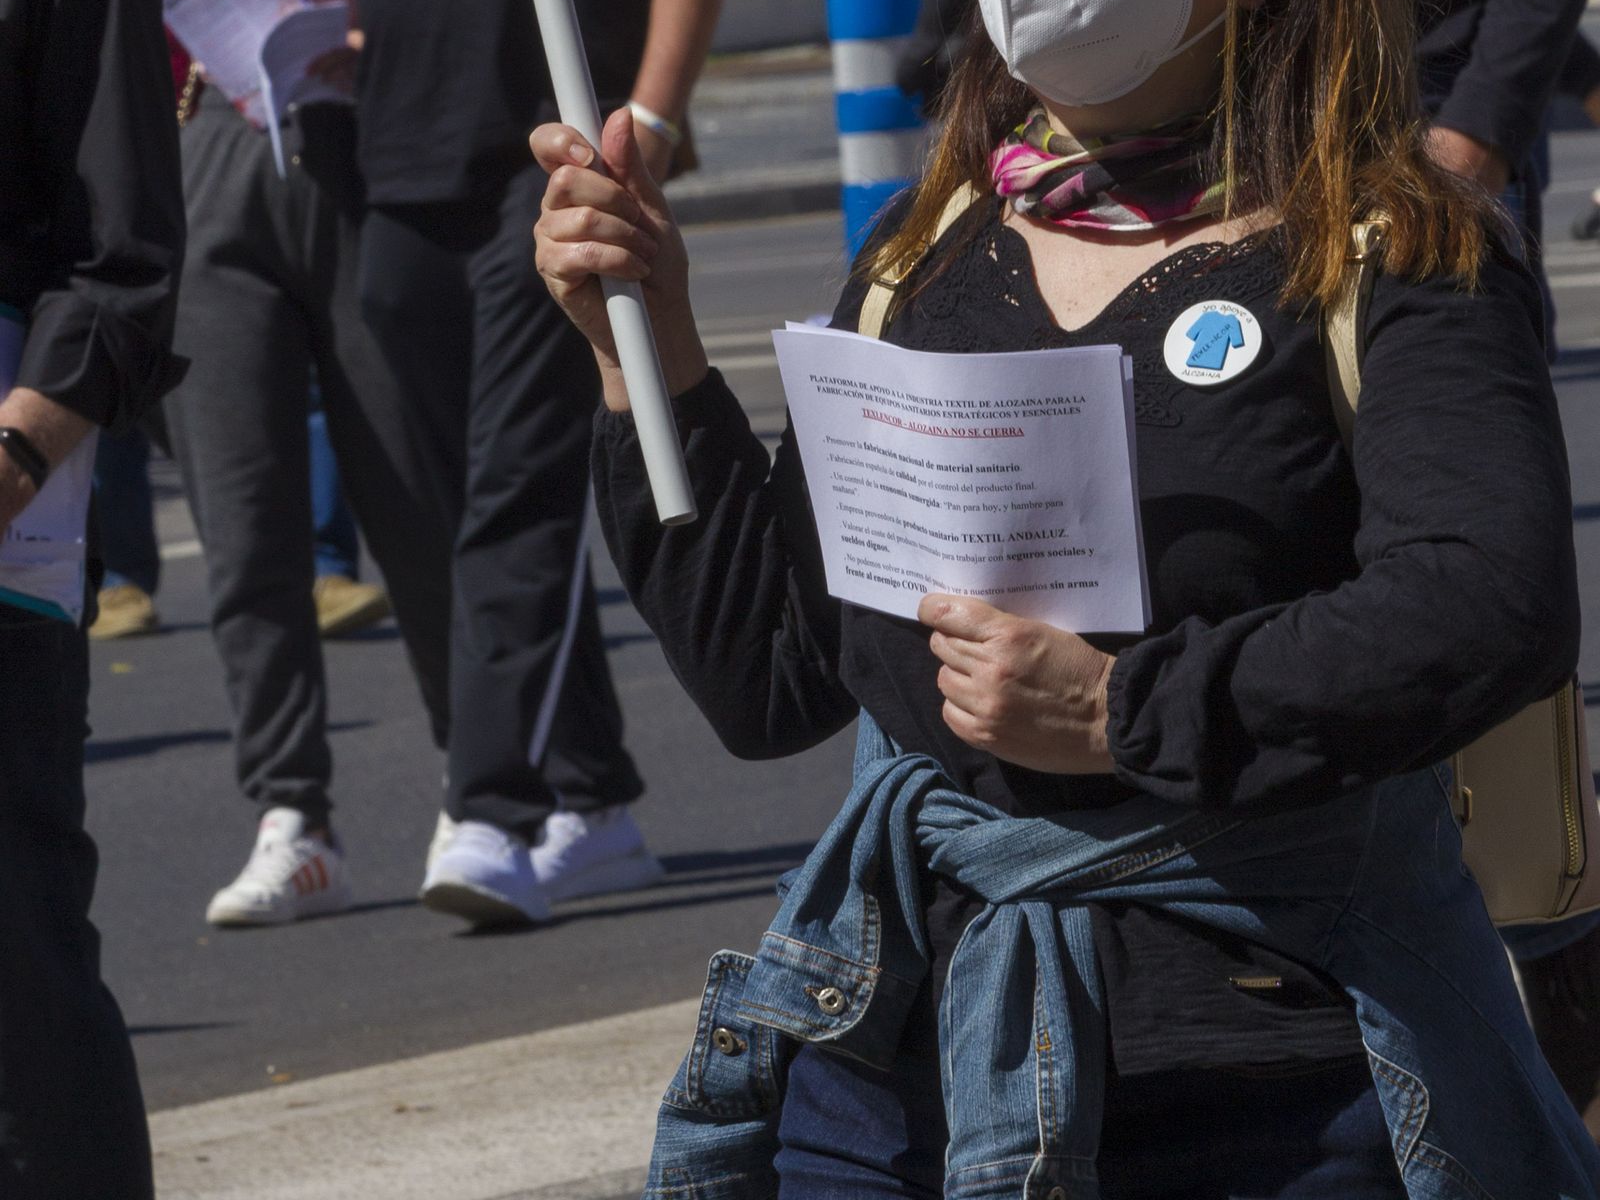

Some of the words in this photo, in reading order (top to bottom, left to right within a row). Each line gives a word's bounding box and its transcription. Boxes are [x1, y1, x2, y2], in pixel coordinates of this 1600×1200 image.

[809, 374, 858, 389] PLATAFORMA
[859, 382, 868, 391] DE
[869, 385, 891, 396] APOYO
[892, 389, 897, 397] A
[897, 390, 905, 400] LA
[906, 393, 943, 408] INDUSTRIA
[944, 399, 977, 409] TEXTIL
[979, 399, 991, 409] DE
[993, 397, 1044, 409] ALOZAINA
[1045, 395, 1072, 406] PARA
[1073, 394, 1087, 404] LA
[816, 385, 865, 400] FABRICACIÓN
[865, 393, 874, 402] DE
[874, 395, 900, 410] EQUIPOS
[900, 402, 941, 419] SANITARIOS
[942, 408, 1012, 420] ESTRATÉGICOS
[1013, 409, 1021, 419] Y
[1022, 406, 1082, 419] ESENCIALES
[862, 407, 903, 427] TEXLENCOR
[908, 422, 950, 438] ALOZAINA
[951, 426, 966, 438] NO
[968, 427, 979, 438] SE
[983, 426, 1025, 438] CIERRA
[857, 441, 863, 450] la
[863, 441, 898, 460] fabricación
[898, 453, 925, 467] nacional
[925, 459, 934, 470] de
[936, 463, 973, 474] material
[975, 462, 1023, 474] sanitario.
[896, 470, 917, 484] calidad
[917, 478, 927, 488] por
[927, 479, 934, 489] el
[934, 482, 959, 493] control
[960, 483, 974, 493] del
[975, 483, 1013, 495] producto
[1015, 481, 1037, 492] final.
[865, 479, 873, 488] de
[873, 480, 879, 490] la
[879, 482, 908, 499] economía
[963, 503, 981, 513] para
[982, 501, 1001, 513] hoy,
[1003, 503, 1009, 513] y
[1011, 500, 1043, 511] hambre
[1045, 500, 1064, 511] para
[841, 534, 865, 548] sueldos
[902, 519, 928, 536] producto
[928, 528, 960, 543] sanitario
[962, 532, 1005, 544] TEXTIL
[1007, 527, 1069, 543] ANDALUZ.
[956, 553, 986, 565] trabajar
[987, 553, 1004, 562] con
[1006, 550, 1045, 563] seguros
[1047, 545, 1086, 558] sociales
[1088, 547, 1095, 558] y
[845, 564, 865, 579] frente
[866, 571, 873, 581] al
[873, 574, 901, 590] enemigo
[951, 586, 962, 594] ver
[970, 585, 1006, 596] nuestros
[1007, 581, 1048, 594] sanitarios
[1049, 580, 1065, 590] sin
[1067, 579, 1099, 589] armas
